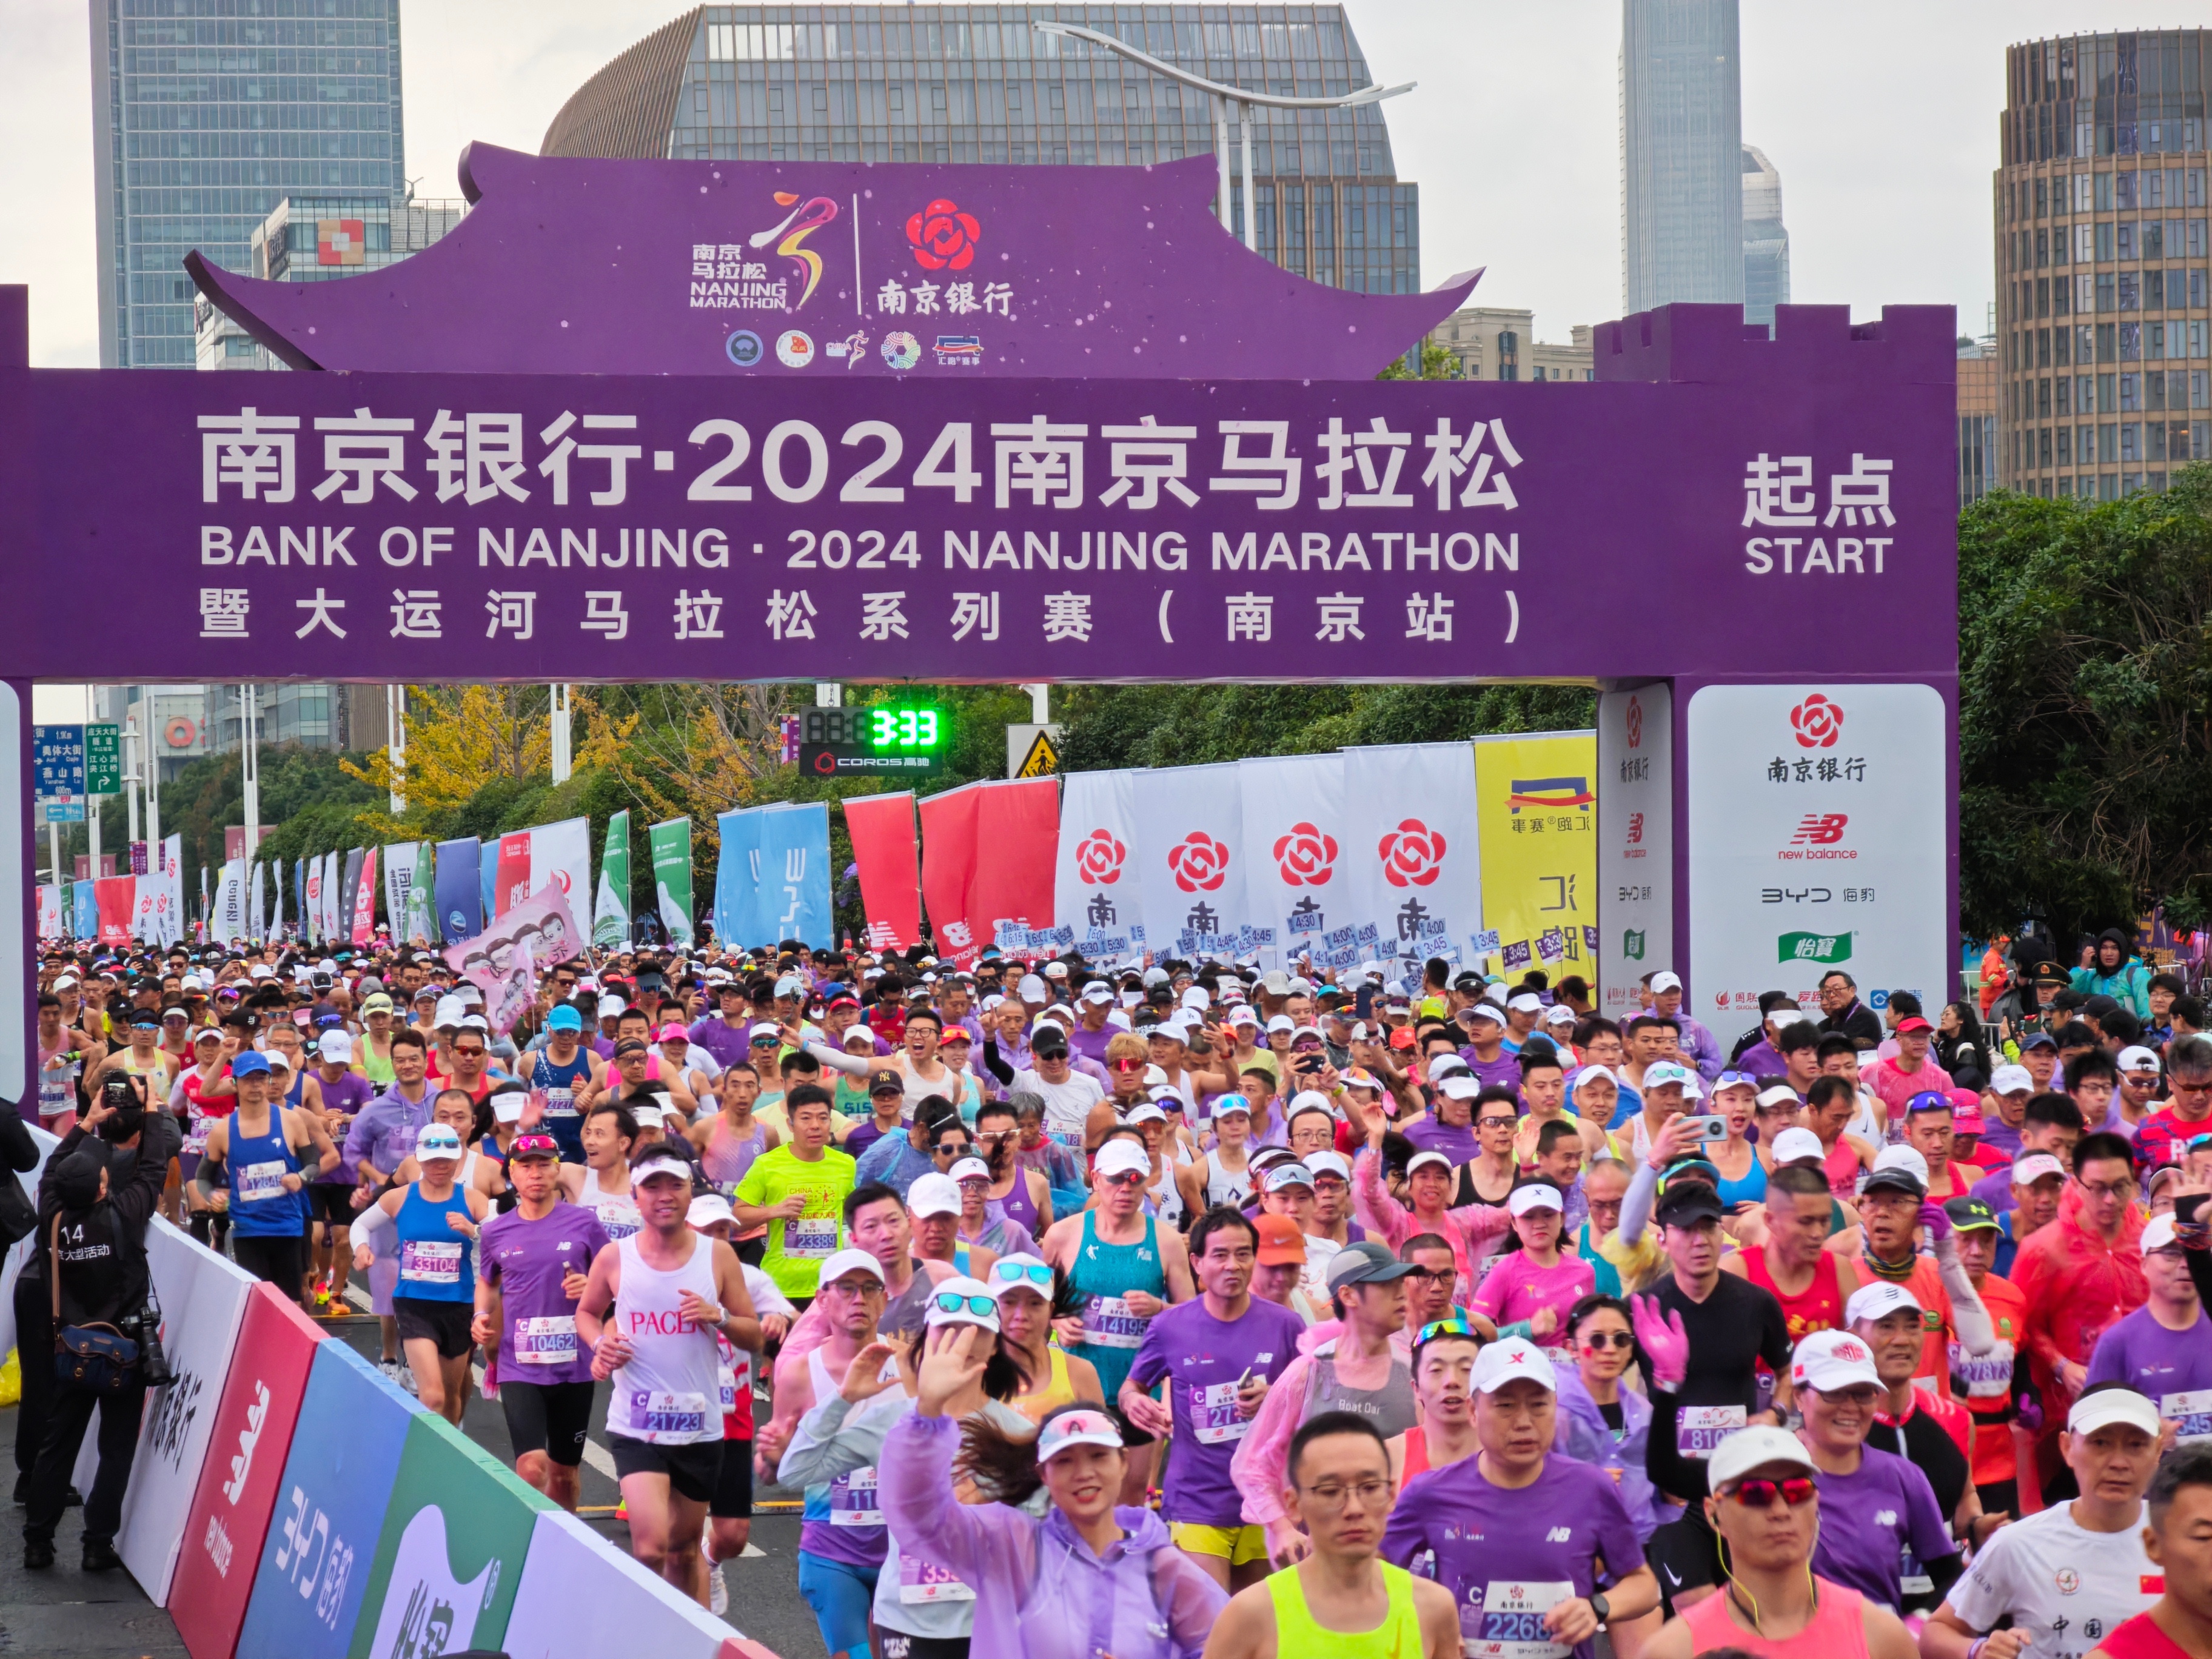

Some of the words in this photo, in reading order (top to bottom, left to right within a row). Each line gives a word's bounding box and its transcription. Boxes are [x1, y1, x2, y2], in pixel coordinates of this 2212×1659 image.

[692, 244, 741, 260] 南京
[692, 263, 766, 280] 马拉松
[691, 282, 786, 297] NANJING
[877, 280, 1013, 315] 南京银行
[689, 297, 785, 309] MARATHON
[1742, 454, 1895, 528] 起点
[202, 526, 357, 565] BANK
[380, 527, 454, 566] OF
[479, 528, 728, 568] NANJING
[788, 530, 920, 568] 2024
[945, 531, 1187, 570] NANJING
[1213, 532, 1518, 571] MARATHON
[1746, 538, 1892, 574] START
[873, 710, 937, 746] 3:33
[42, 745, 81, 756] 奥体大街
[837, 758, 902, 767] COROS
[904, 757, 930, 767] 高驰
[1620, 757, 1649, 783] 南京银行
[1768, 756, 1867, 783] 南京银行
[42, 767, 82, 777] 燕山路
[1778, 850, 1805, 859] new
[1807, 848, 1857, 859] balance
[1762, 888, 1831, 903] BYD
[1843, 888, 1875, 903] 海豹
[1296, 915, 1315, 928] 4:30
[1427, 921, 1444, 934] 4:00
[1008, 934, 1023, 943] 6:15
[1092, 930, 1105, 939] 6:00
[1358, 924, 1378, 941] 4:00
[1478, 931, 1498, 947] 3:45
[1081, 942, 1099, 954] 5:30
[1107, 939, 1125, 951] 5:30
[1238, 937, 1255, 951] 4:30
[1424, 936, 1447, 954] 3:45
[1509, 943, 1527, 960] 3:45
[1795, 938, 1836, 957] 怡寶
[1335, 950, 1355, 966] 4:00
[61, 1224, 84, 1244] 14
[789, 1222, 796, 1231] C
[798, 1234, 835, 1248] 23389
[415, 1256, 457, 1272] 33104
[520, 1321, 528, 1332] C
[630, 1310, 708, 1335] PACE
[1100, 1316, 1148, 1335] 14195
[529, 1335, 574, 1352] 10462
[1759, 1376, 1771, 1388] C
[637, 1394, 647, 1406] C
[1194, 1391, 1205, 1404] C
[648, 1413, 700, 1431] 21723
[275, 1484, 329, 1600] BYD
[315, 1534, 354, 1631] 海豹
[1469, 1587, 1483, 1604] C
[1501, 1601, 1533, 1610] 南京银行
